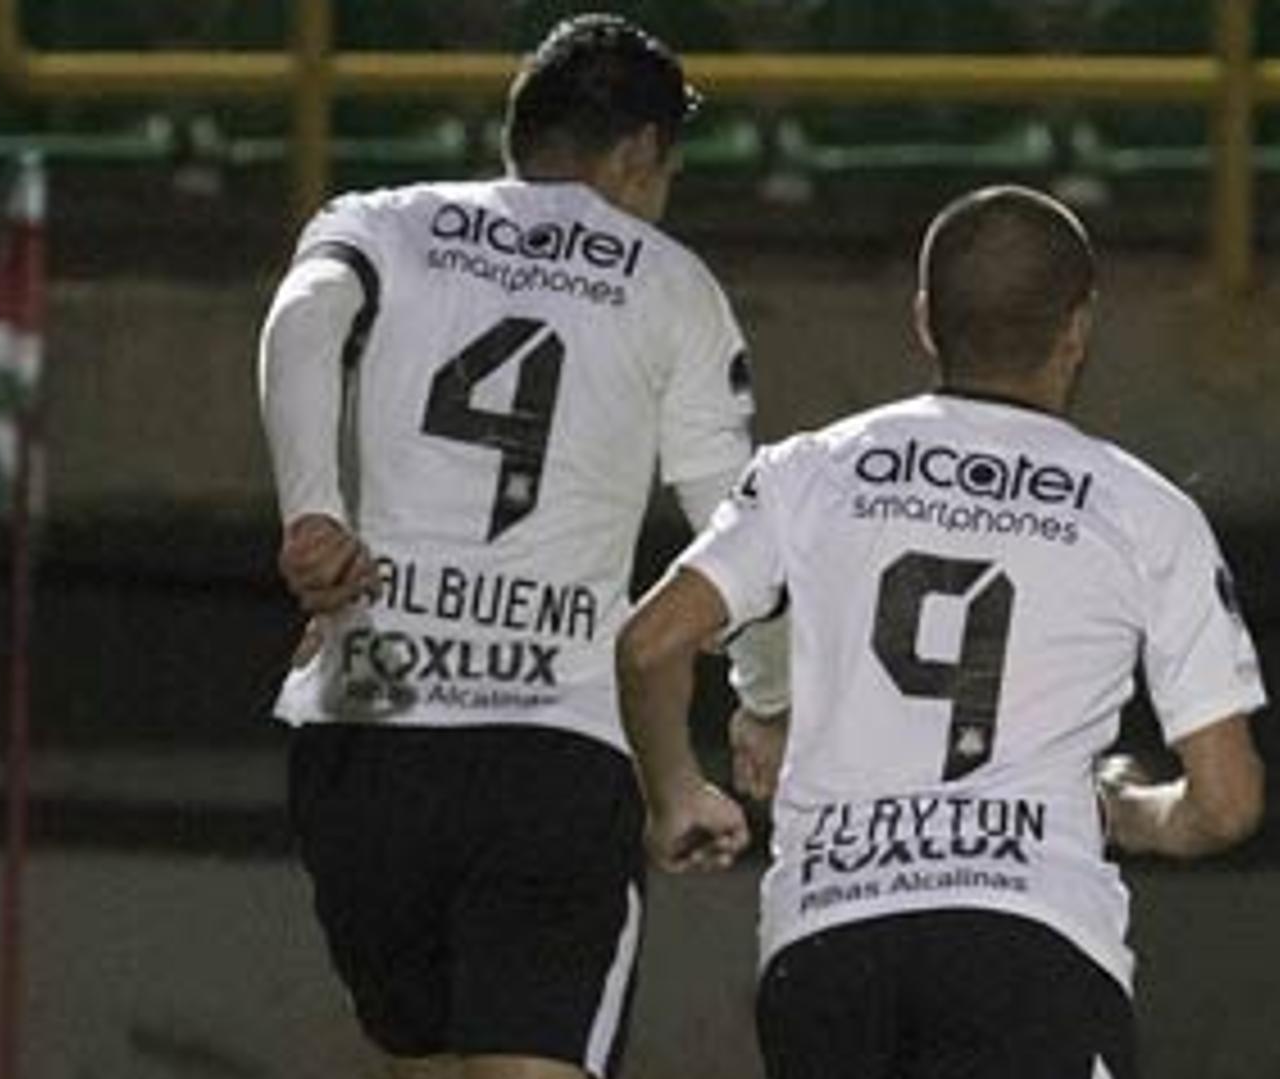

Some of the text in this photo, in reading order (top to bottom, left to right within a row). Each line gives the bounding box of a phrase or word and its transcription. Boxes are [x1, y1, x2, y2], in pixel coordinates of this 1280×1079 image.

[431, 203, 643, 277] alcatel
[426, 248, 626, 306] smartphones
[421, 315, 567, 545] 4
[855, 438, 1093, 510] alcatel
[853, 493, 1080, 546] smartphones
[371, 556, 599, 641] ALBUENA
[342, 627, 562, 687] FOXLUX
[870, 549, 1016, 783] 9
